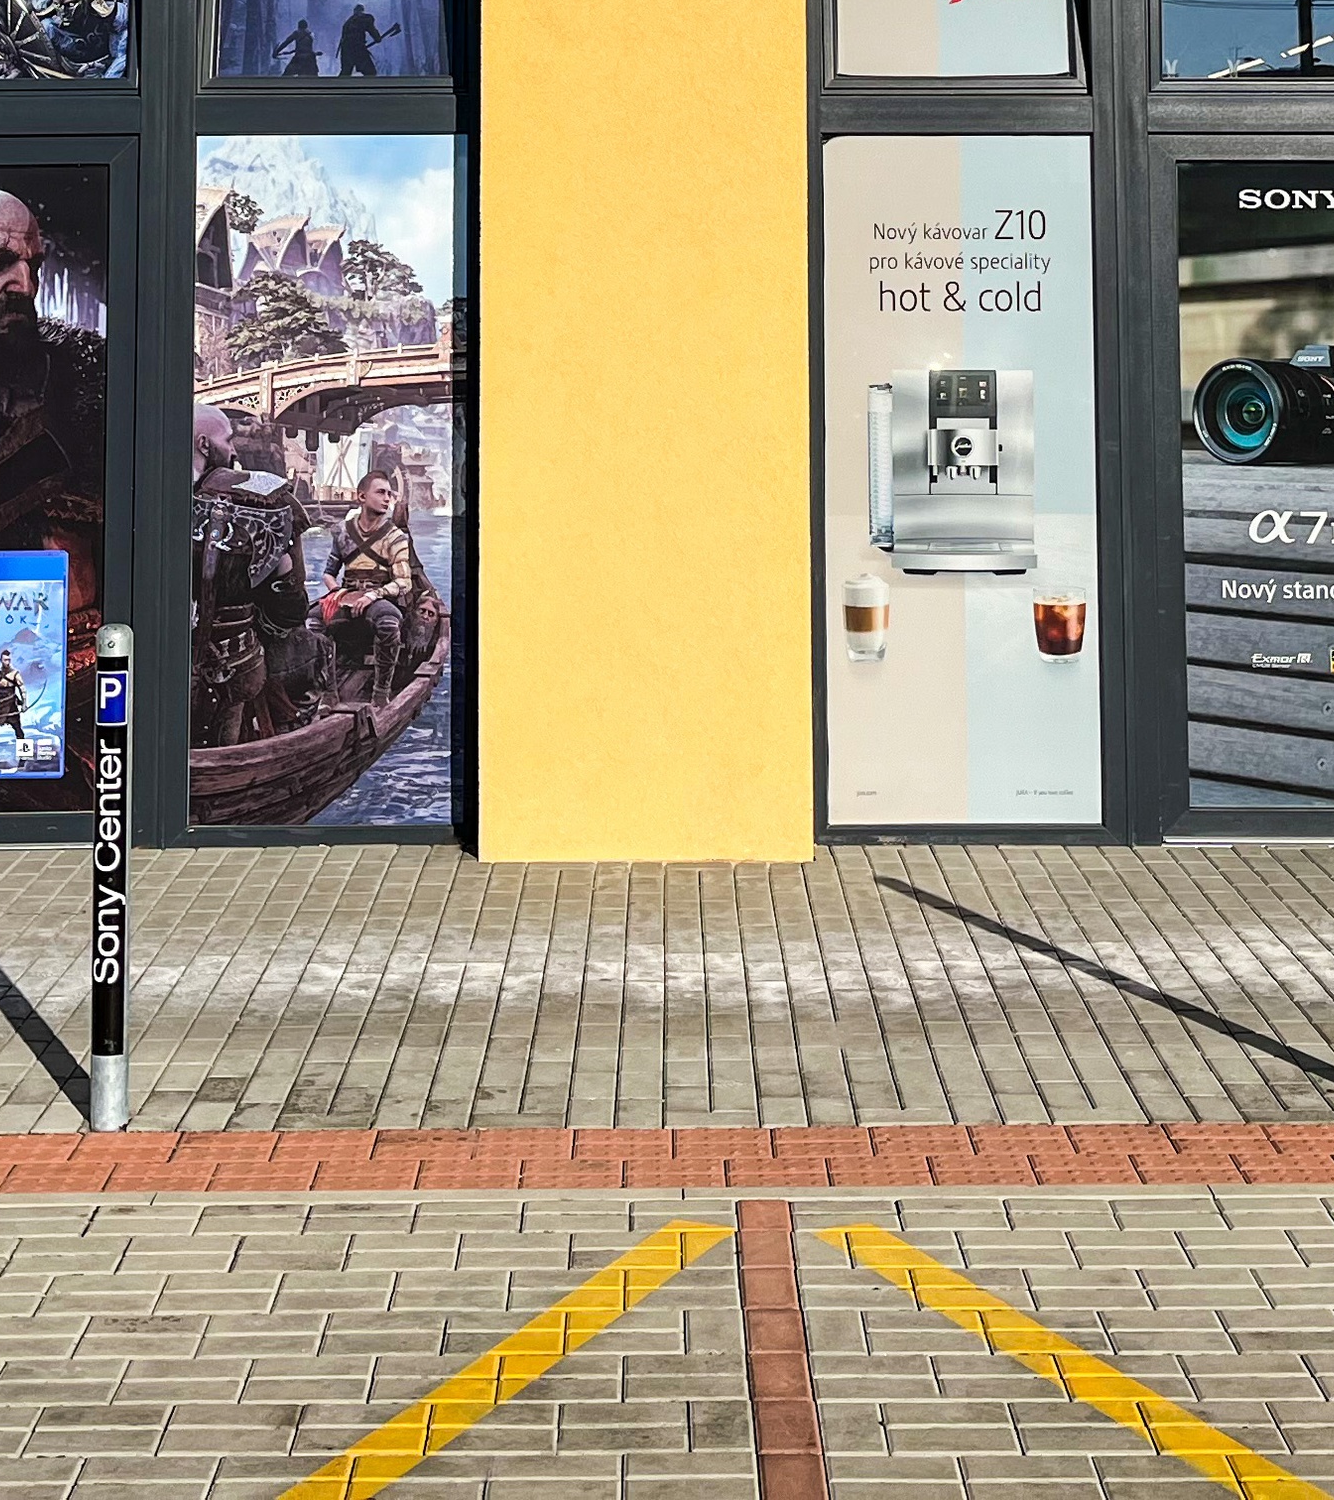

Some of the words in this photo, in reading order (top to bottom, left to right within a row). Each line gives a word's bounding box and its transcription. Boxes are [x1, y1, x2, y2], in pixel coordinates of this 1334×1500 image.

[873, 222, 917, 244] Nový
[923, 222, 988, 240] kávovar
[994, 210, 1046, 240] Z10
[869, 256, 898, 273] pro
[904, 251, 964, 269] kávové
[970, 251, 1051, 274] speciality
[879, 280, 931, 312] hot
[943, 281, 966, 312] &
[978, 280, 1041, 312] cold
[1222, 579, 1277, 603] Nový
[1251, 653, 1296, 663] Exmor
[100, 678, 122, 709] P
[94, 739, 122, 872] Center
[93, 884, 126, 985] Sony
